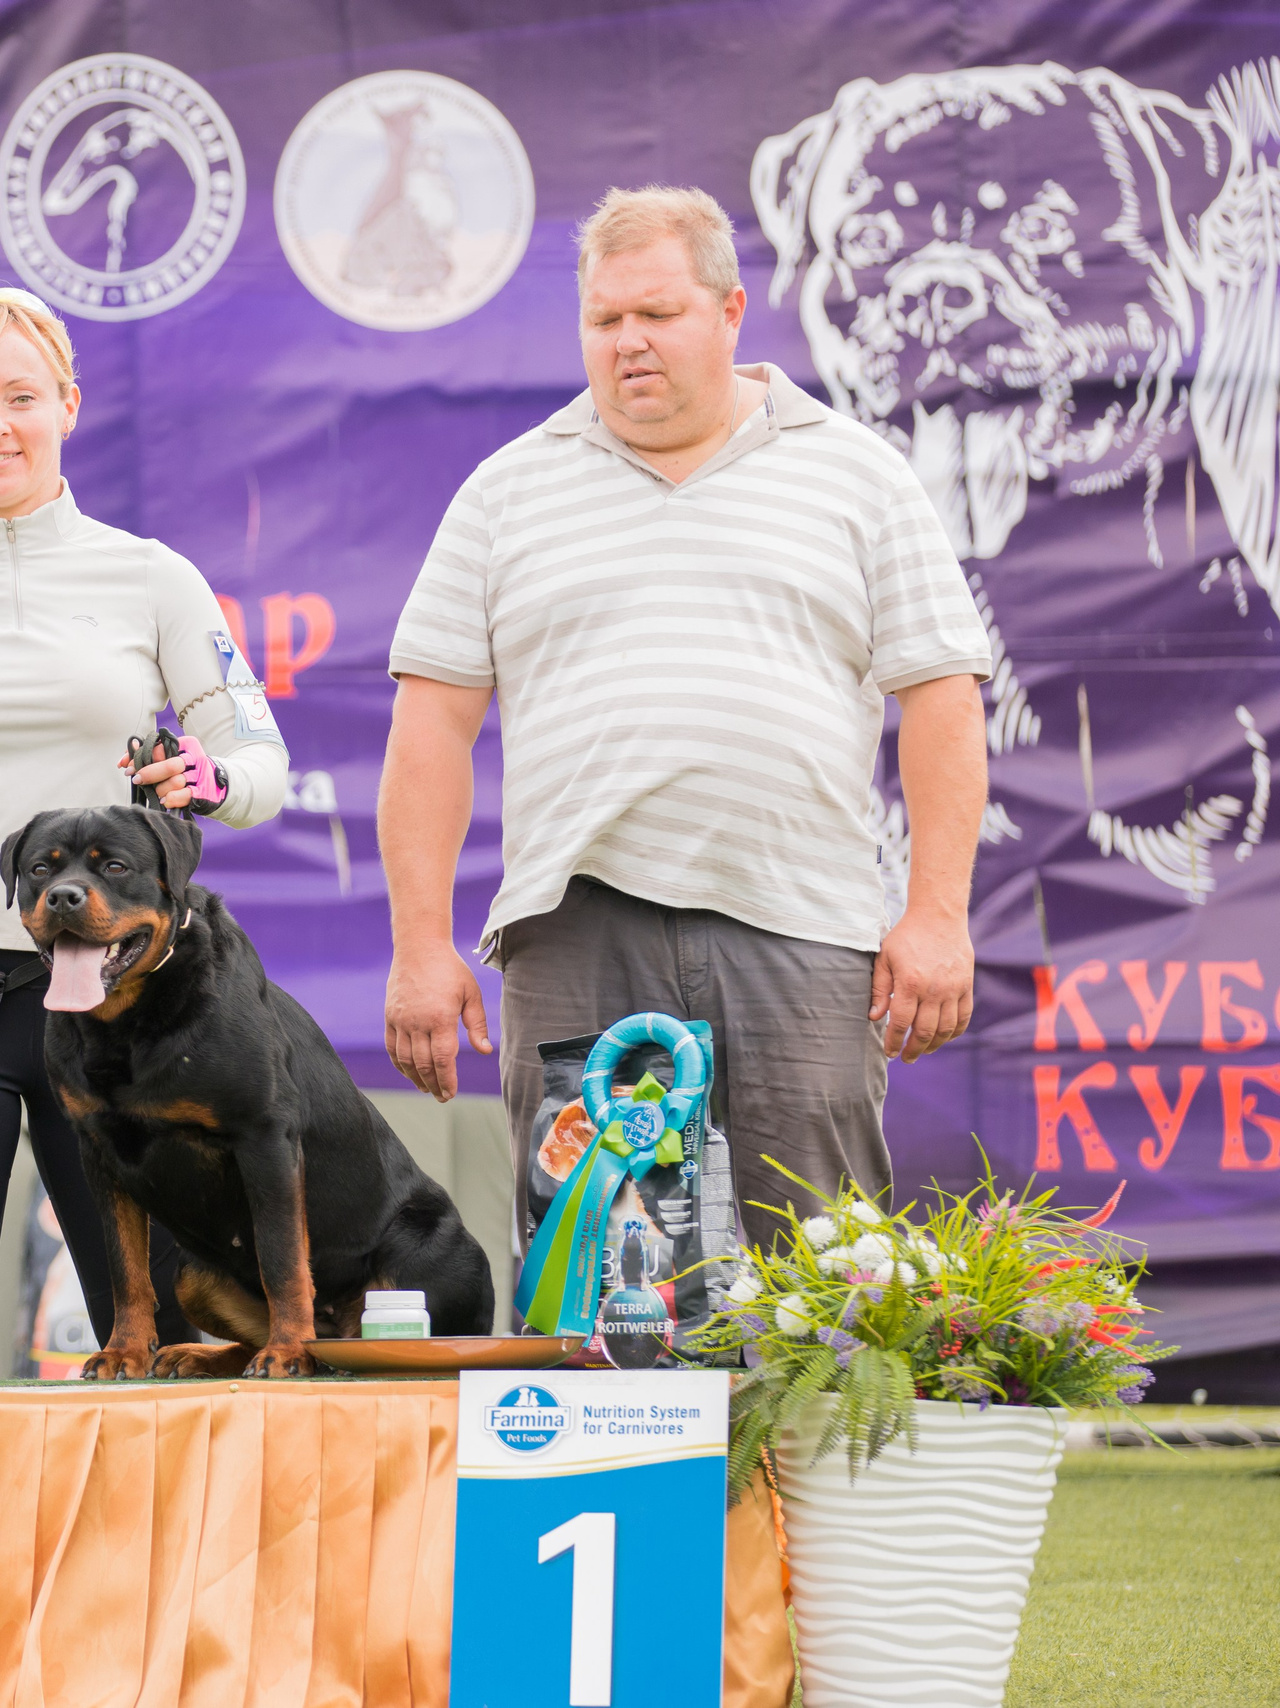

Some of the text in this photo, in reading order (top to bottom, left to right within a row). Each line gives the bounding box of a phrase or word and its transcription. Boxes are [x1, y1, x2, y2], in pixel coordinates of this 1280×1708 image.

[250, 693, 268, 721] 5
[1033, 960, 1280, 1053] КУБ
[613, 1303, 653, 1315] TERRA
[598, 1321, 674, 1334] ROTTWEILER
[491, 1409, 565, 1427] Farmina
[583, 1405, 700, 1421] Nutrition System
[583, 1421, 684, 1434] for Carnivores
[506, 1433, 548, 1443] Pet Foods
[538, 1512, 616, 1707] 1
